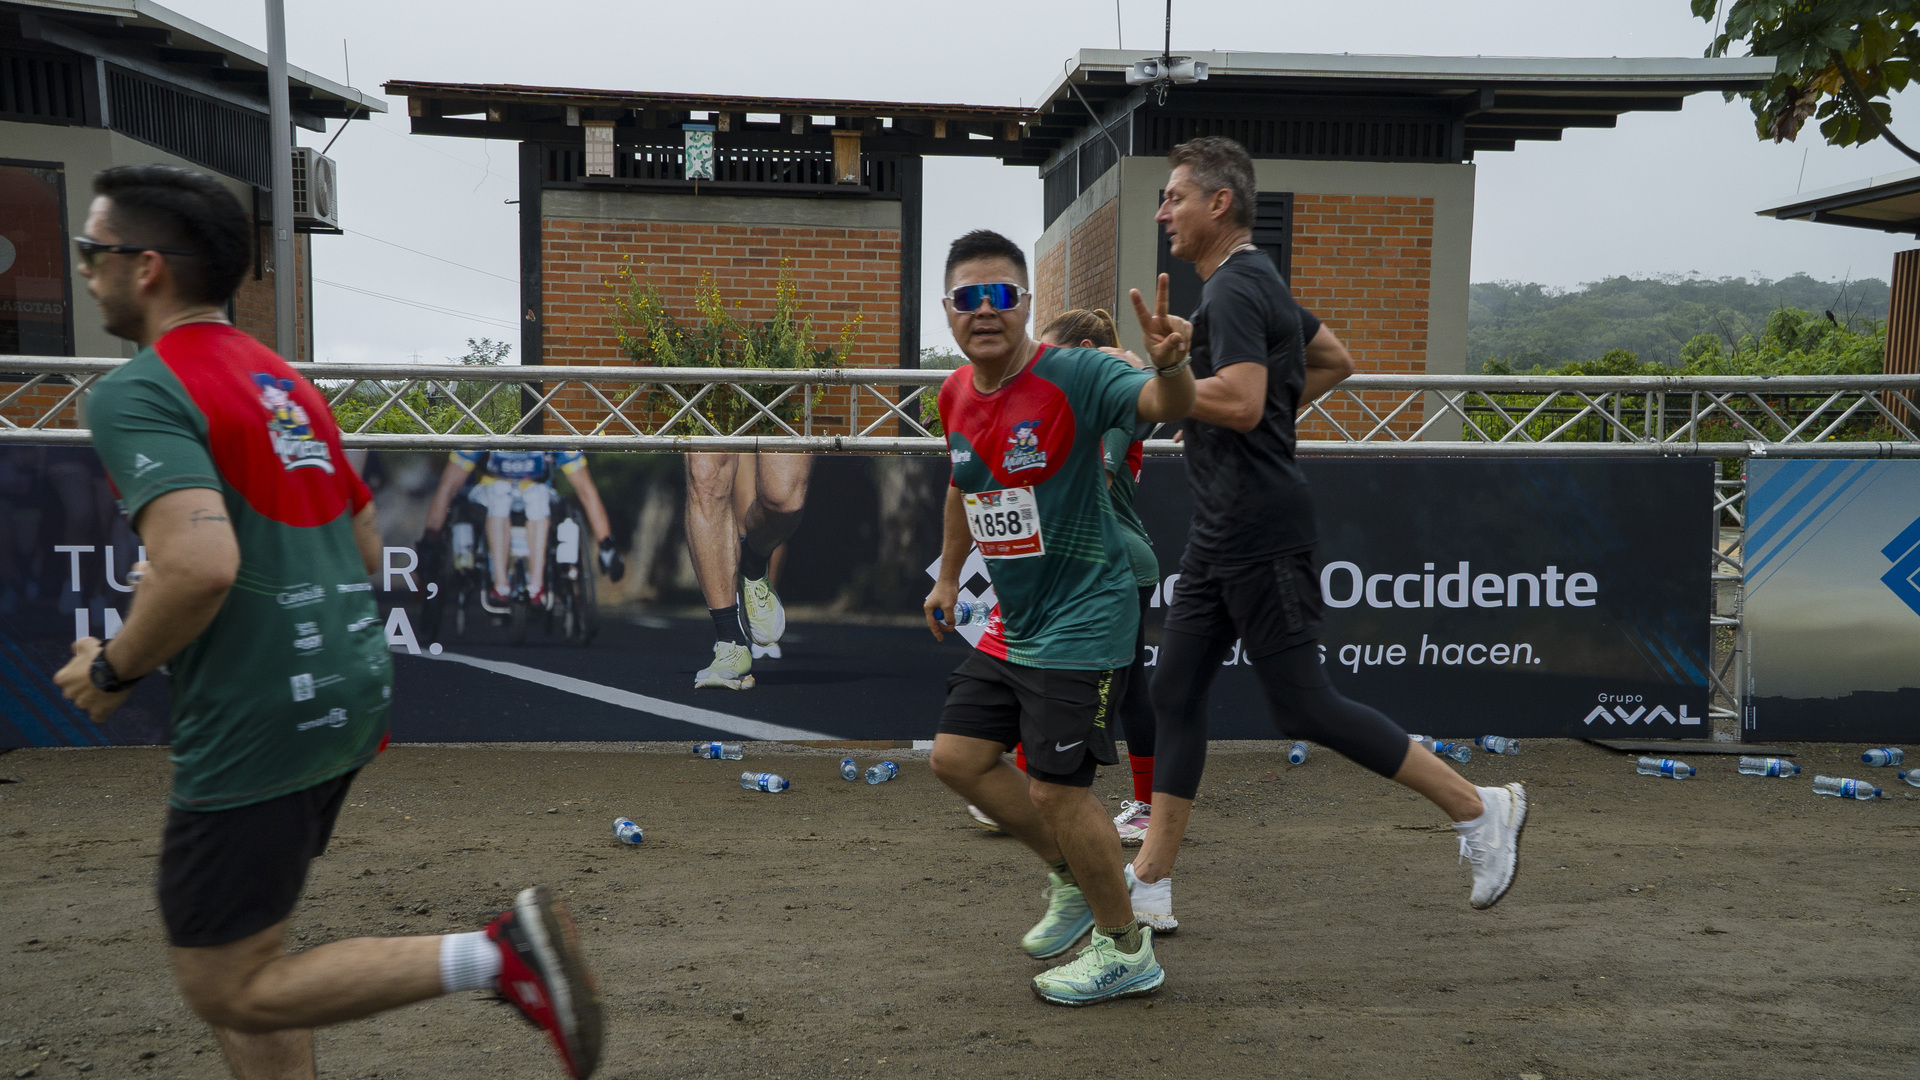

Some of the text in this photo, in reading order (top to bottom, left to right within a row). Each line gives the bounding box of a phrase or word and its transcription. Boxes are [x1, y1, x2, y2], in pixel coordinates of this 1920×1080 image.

[974, 511, 1022, 538] 1858
[1321, 560, 1598, 609] Occidente
[1338, 644, 1406, 675] que
[1418, 633, 1542, 666] hacen.
[1597, 692, 1645, 706] Grupo
[1583, 704, 1701, 725] AVAL
[1095, 964, 1128, 990] HOKA
